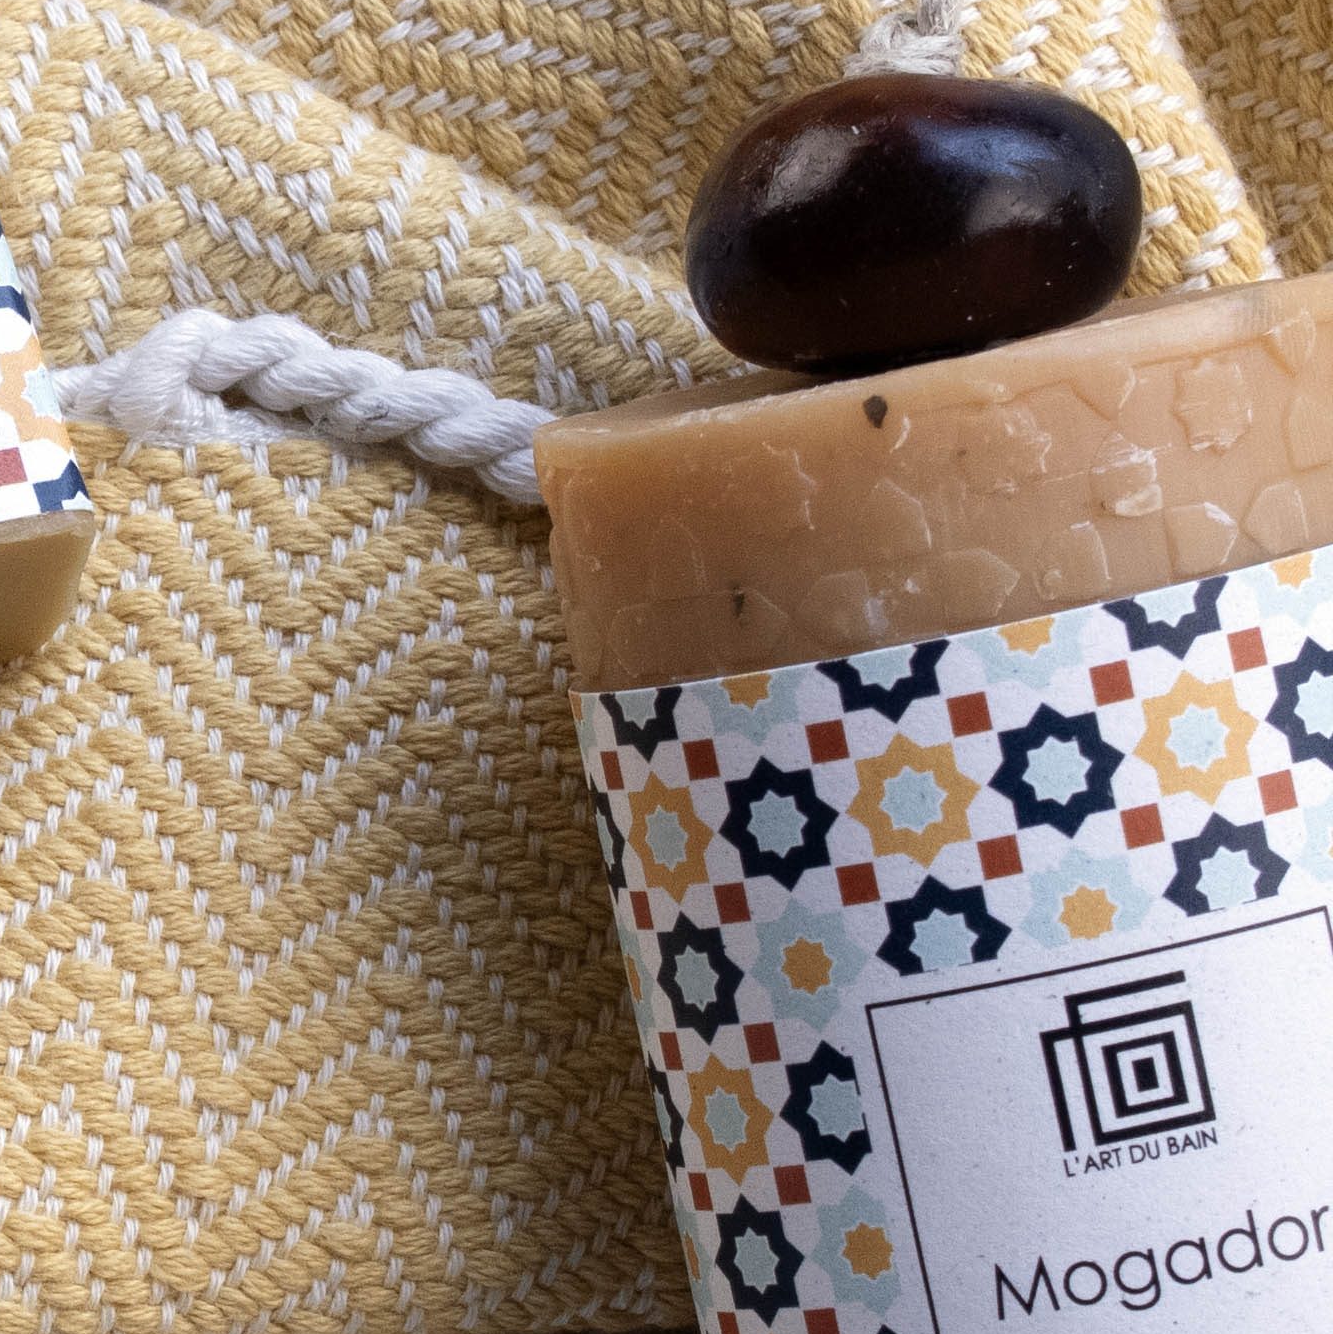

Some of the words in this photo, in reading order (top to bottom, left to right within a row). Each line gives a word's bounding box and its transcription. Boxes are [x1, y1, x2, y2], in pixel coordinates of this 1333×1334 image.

[1063, 1146, 1121, 1178] L'ART
[1127, 1139, 1161, 1165] DU
[1165, 1126, 1218, 1156] BAIN
[994, 1206, 1328, 1322] Mogador
